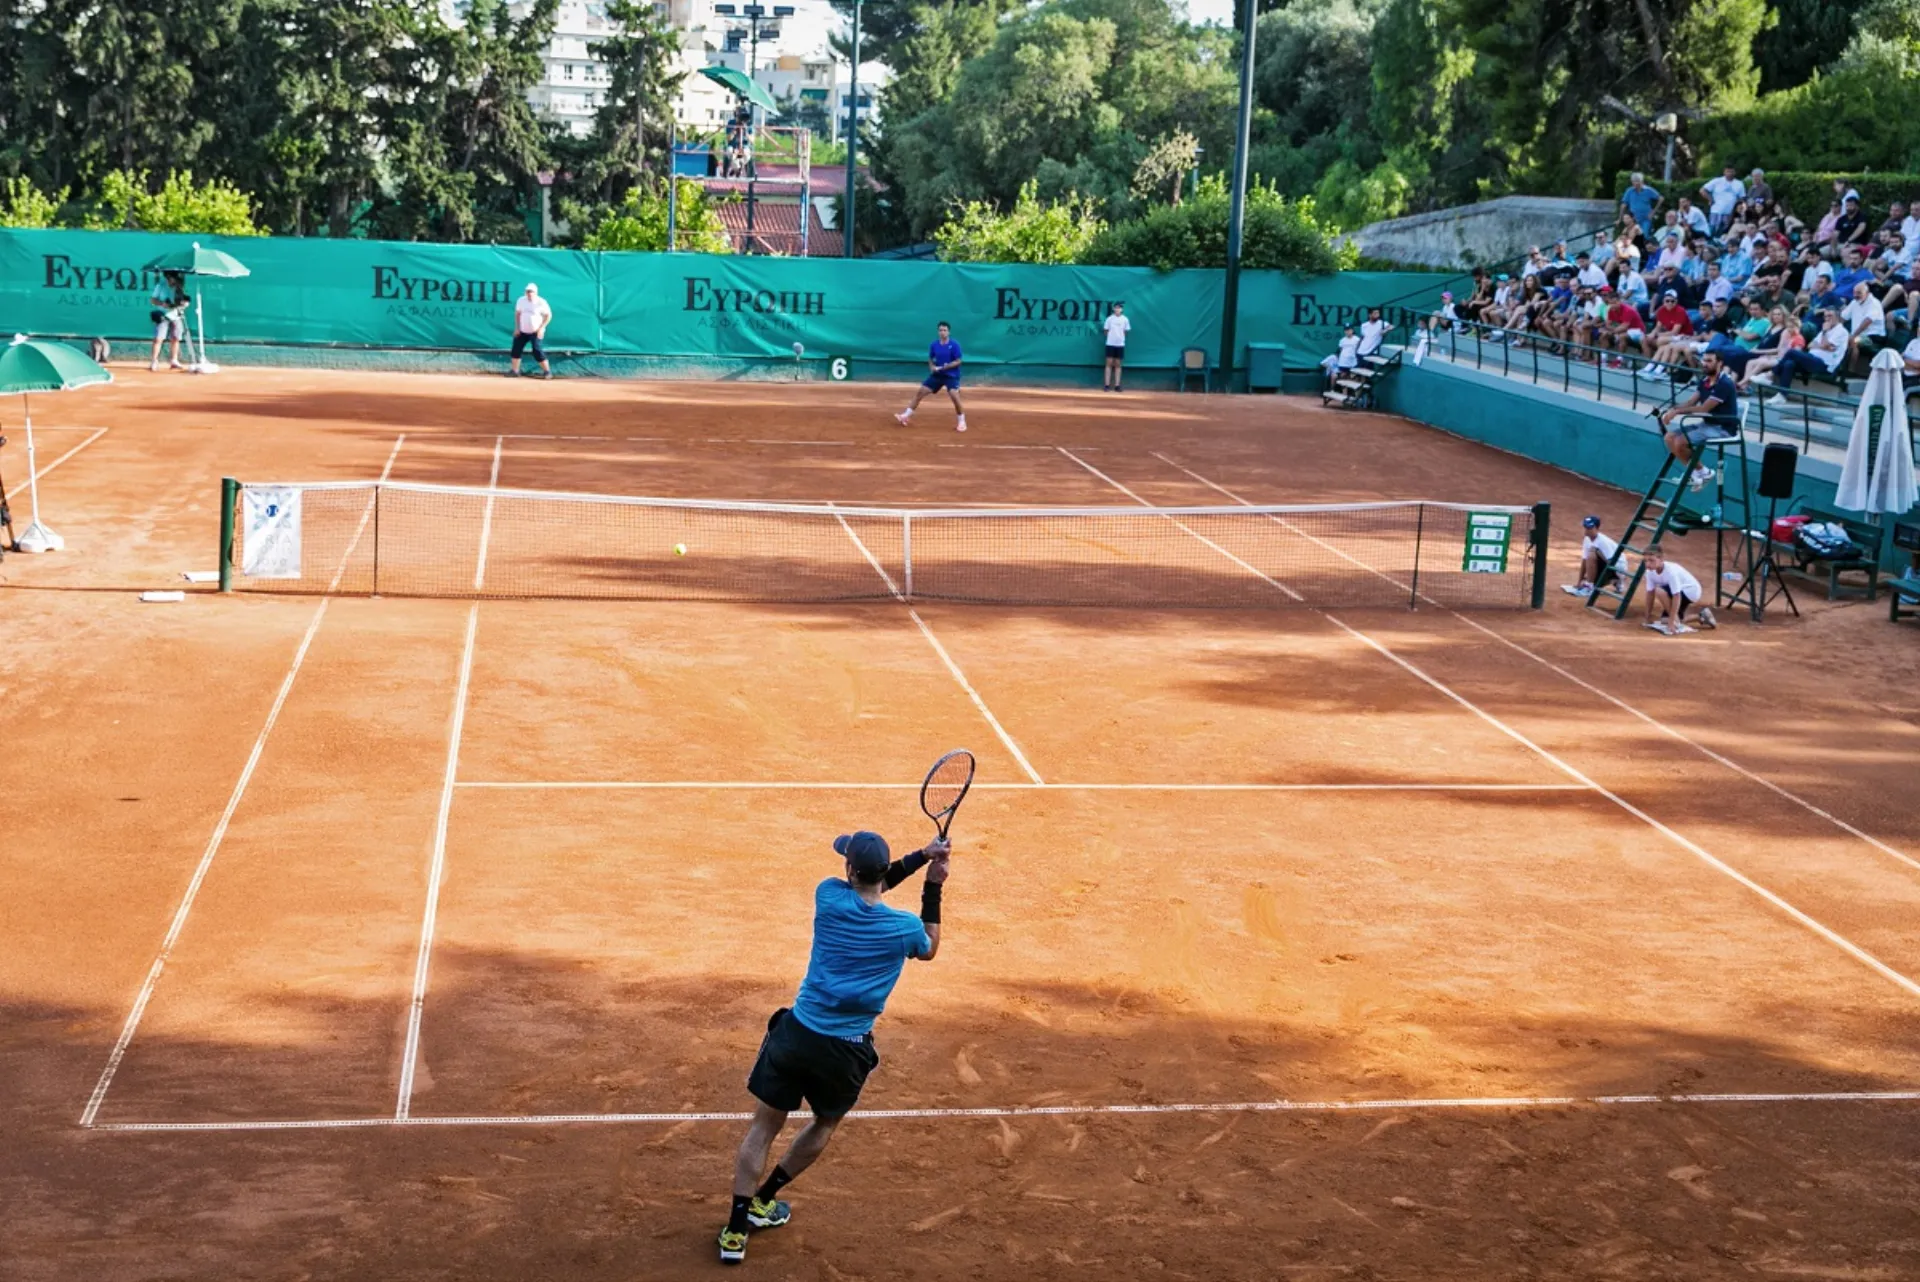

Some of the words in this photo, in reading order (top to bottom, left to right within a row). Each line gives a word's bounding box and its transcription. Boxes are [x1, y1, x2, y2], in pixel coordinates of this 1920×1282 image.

[42, 254, 160, 292] ΕΥΡΩΠ
[371, 266, 511, 303] ΕΥΡΩΠΗ
[683, 277, 826, 315] ΕΥΡΩΠΗ
[832, 358, 847, 380] 6
